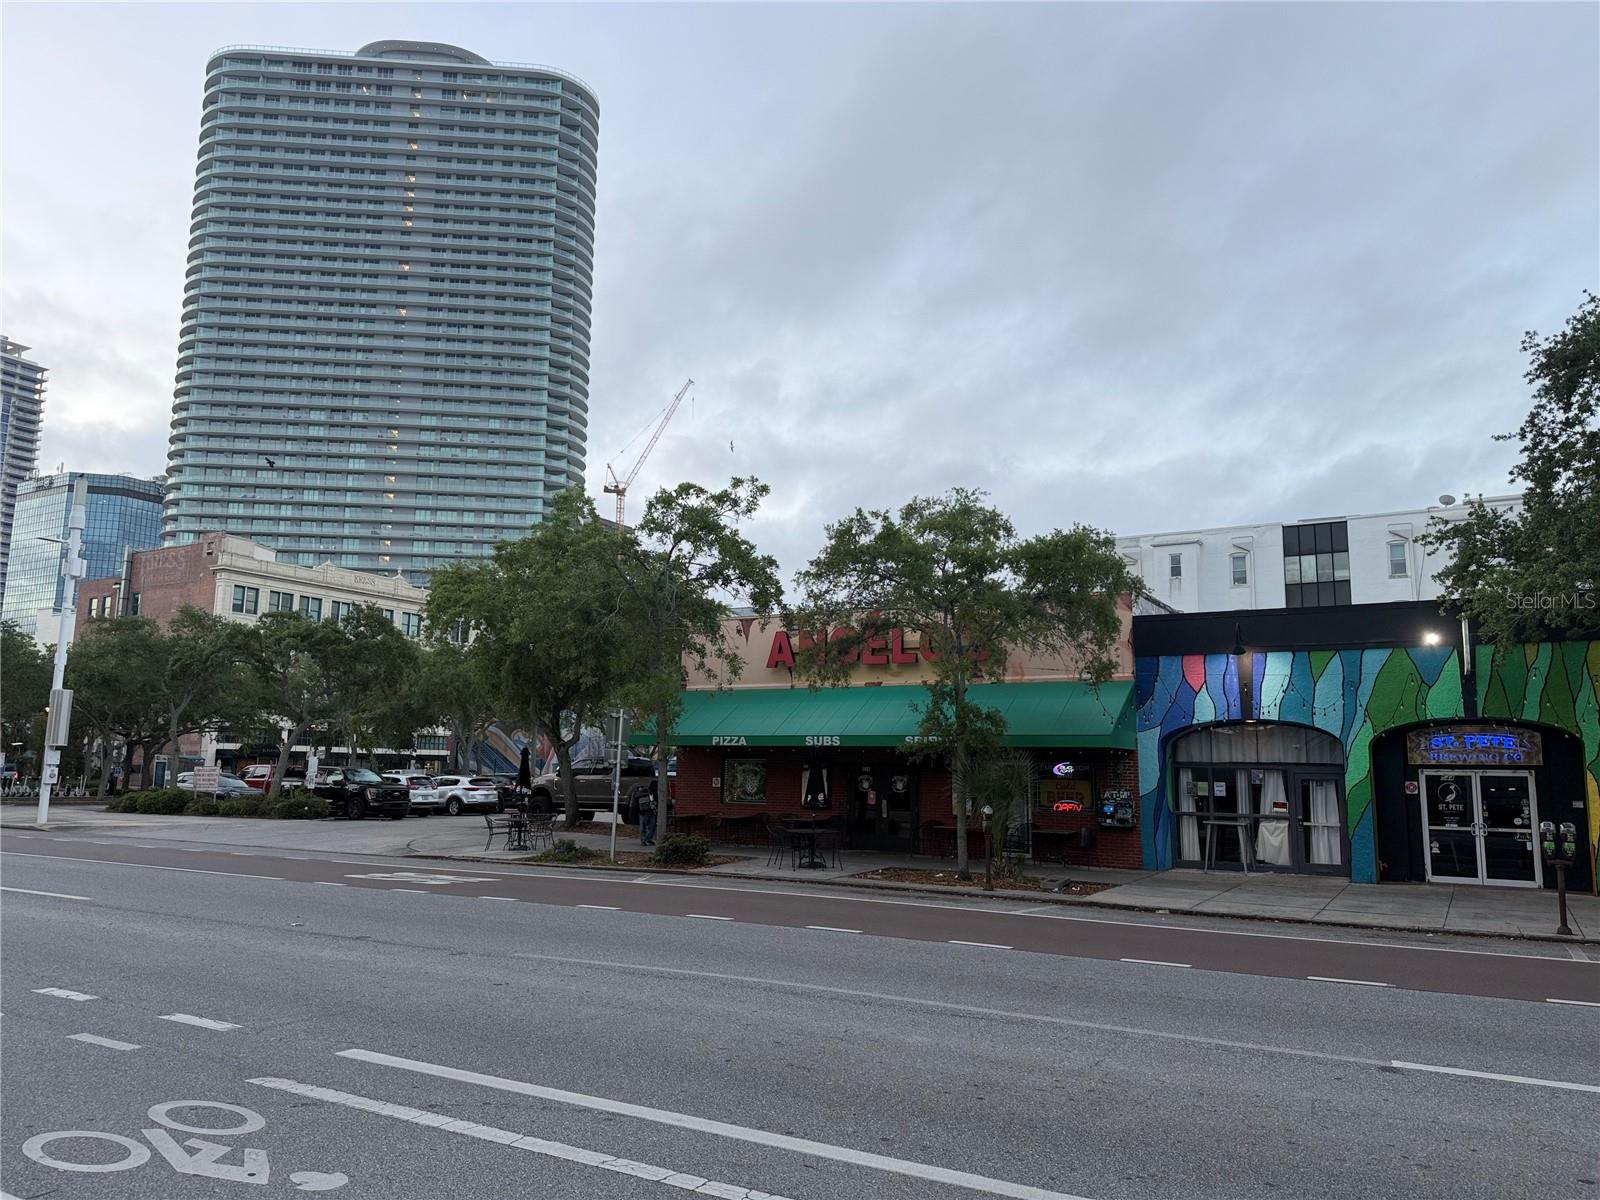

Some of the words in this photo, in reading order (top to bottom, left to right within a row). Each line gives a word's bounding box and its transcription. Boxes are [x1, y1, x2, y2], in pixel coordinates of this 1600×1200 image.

[711, 736, 747, 746] PIZZA
[805, 735, 841, 746] SUBS
[1430, 735, 1458, 748] ST.
[1463, 735, 1516, 749] PETE
[1053, 802, 1082, 812] OPEN
[1438, 803, 1448, 811] ST.
[1448, 803, 1465, 811] PETE
